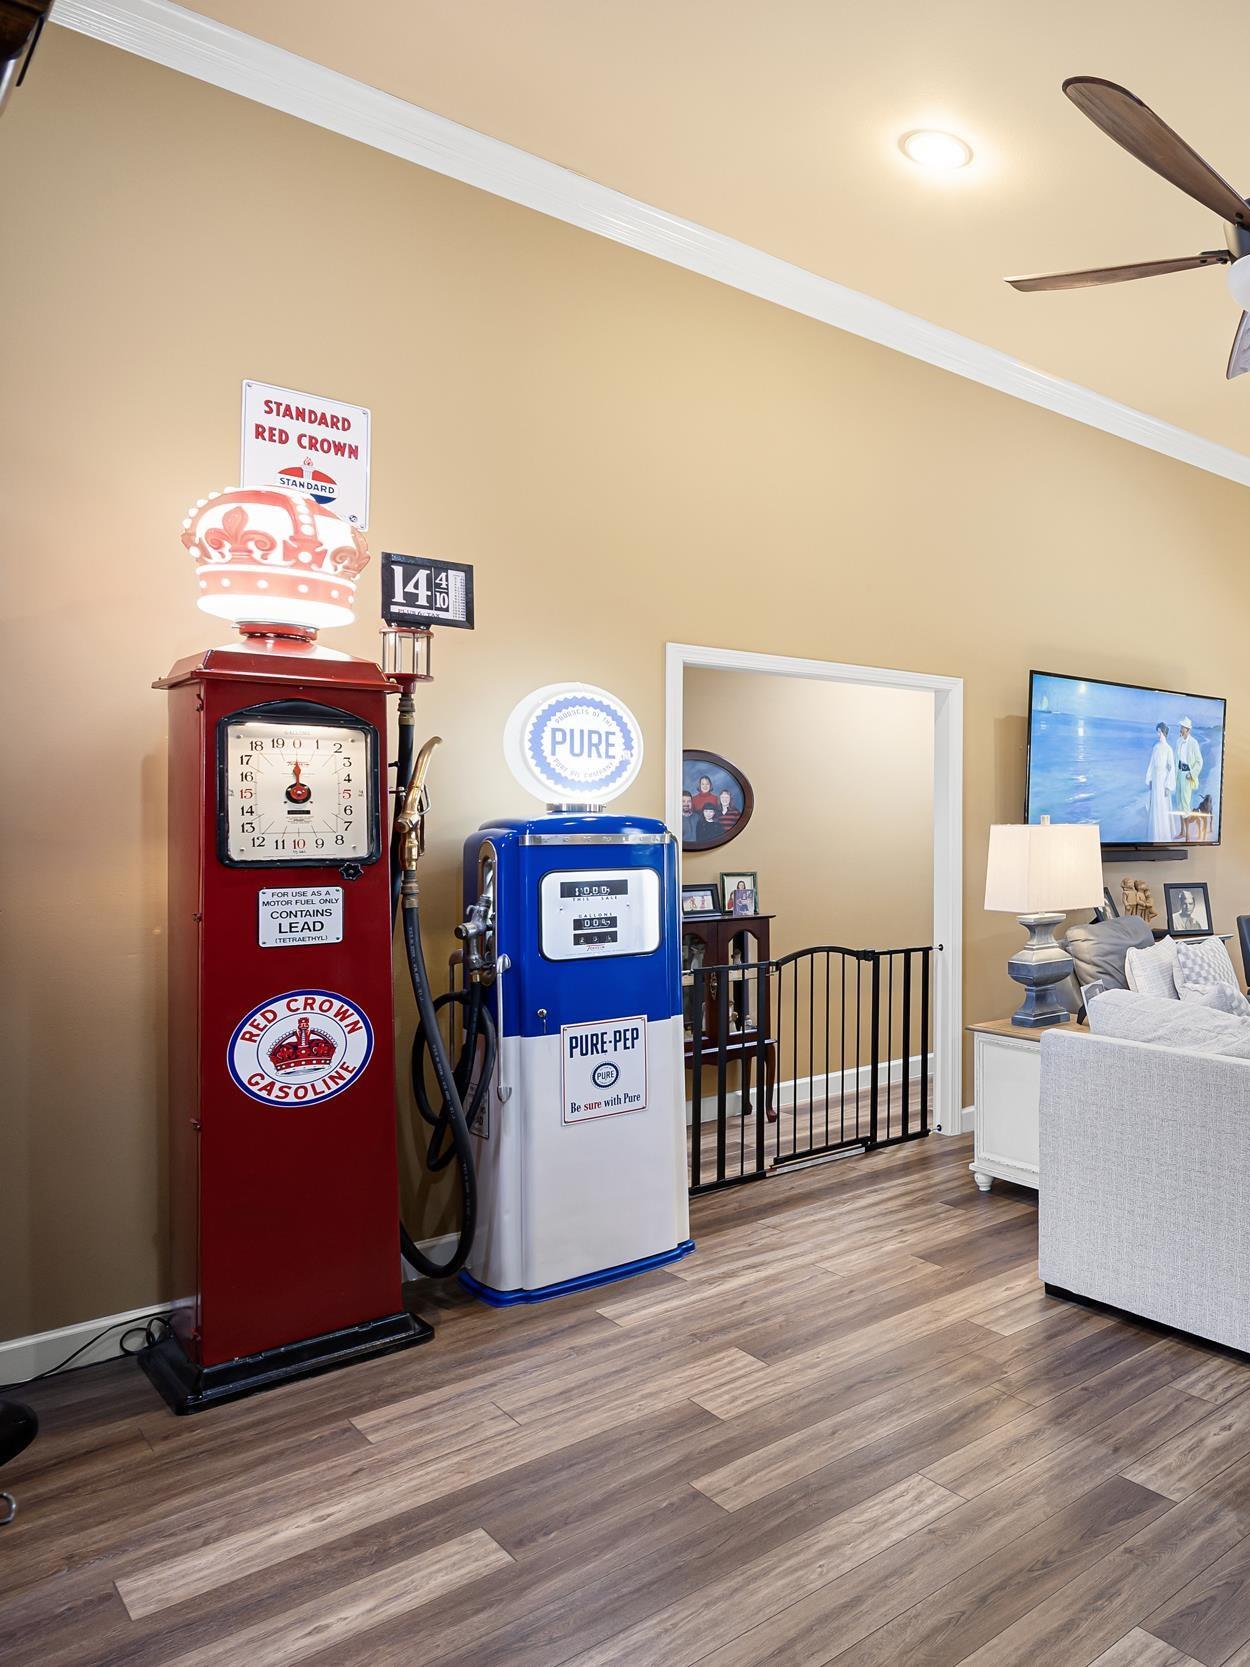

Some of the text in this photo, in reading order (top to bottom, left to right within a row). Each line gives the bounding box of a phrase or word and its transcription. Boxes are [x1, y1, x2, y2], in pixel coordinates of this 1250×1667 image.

[263, 399, 352, 432] STANDARD
[254, 423, 359, 460] RED CROWN
[279, 477, 335, 494] STANDARD
[391, 565, 431, 606] 14
[435, 572, 448, 589] 4
[435, 592, 449, 609] 10
[250, 741, 264, 751] 18
[271, 738, 285, 749] 19
[292, 739, 302, 749] 0
[316, 739, 320, 749] 1
[333, 743, 342, 753] 2
[551, 728, 616, 759] PURE
[240, 755, 252, 765] 17
[342, 757, 352, 767] 3
[240, 772, 254, 782] 16
[343, 773, 352, 783] 4
[240, 789, 253, 799] 15
[342, 789, 352, 799] 5
[240, 805, 255, 816] 14
[343, 805, 353, 815] 6
[240, 822, 255, 833] 13
[343, 821, 353, 831] 7
[252, 837, 265, 847] 12
[275, 840, 286, 850] 11
[293, 839, 306, 849] 10
[315, 838, 325, 848] 9
[335, 835, 345, 845] 8
[270, 908, 333, 920] CONTAINS
[278, 920, 324, 934] LEAD
[275, 935, 328, 944] (TETRAETHYL)
[240, 996, 363, 1044] RED CROWN
[569, 1027, 639, 1058] PURE-PEP
[597, 1070, 614, 1080] PURE
[246, 1061, 357, 1100] GASOLINE
[570, 1093, 640, 1114] Be sure with Pure
